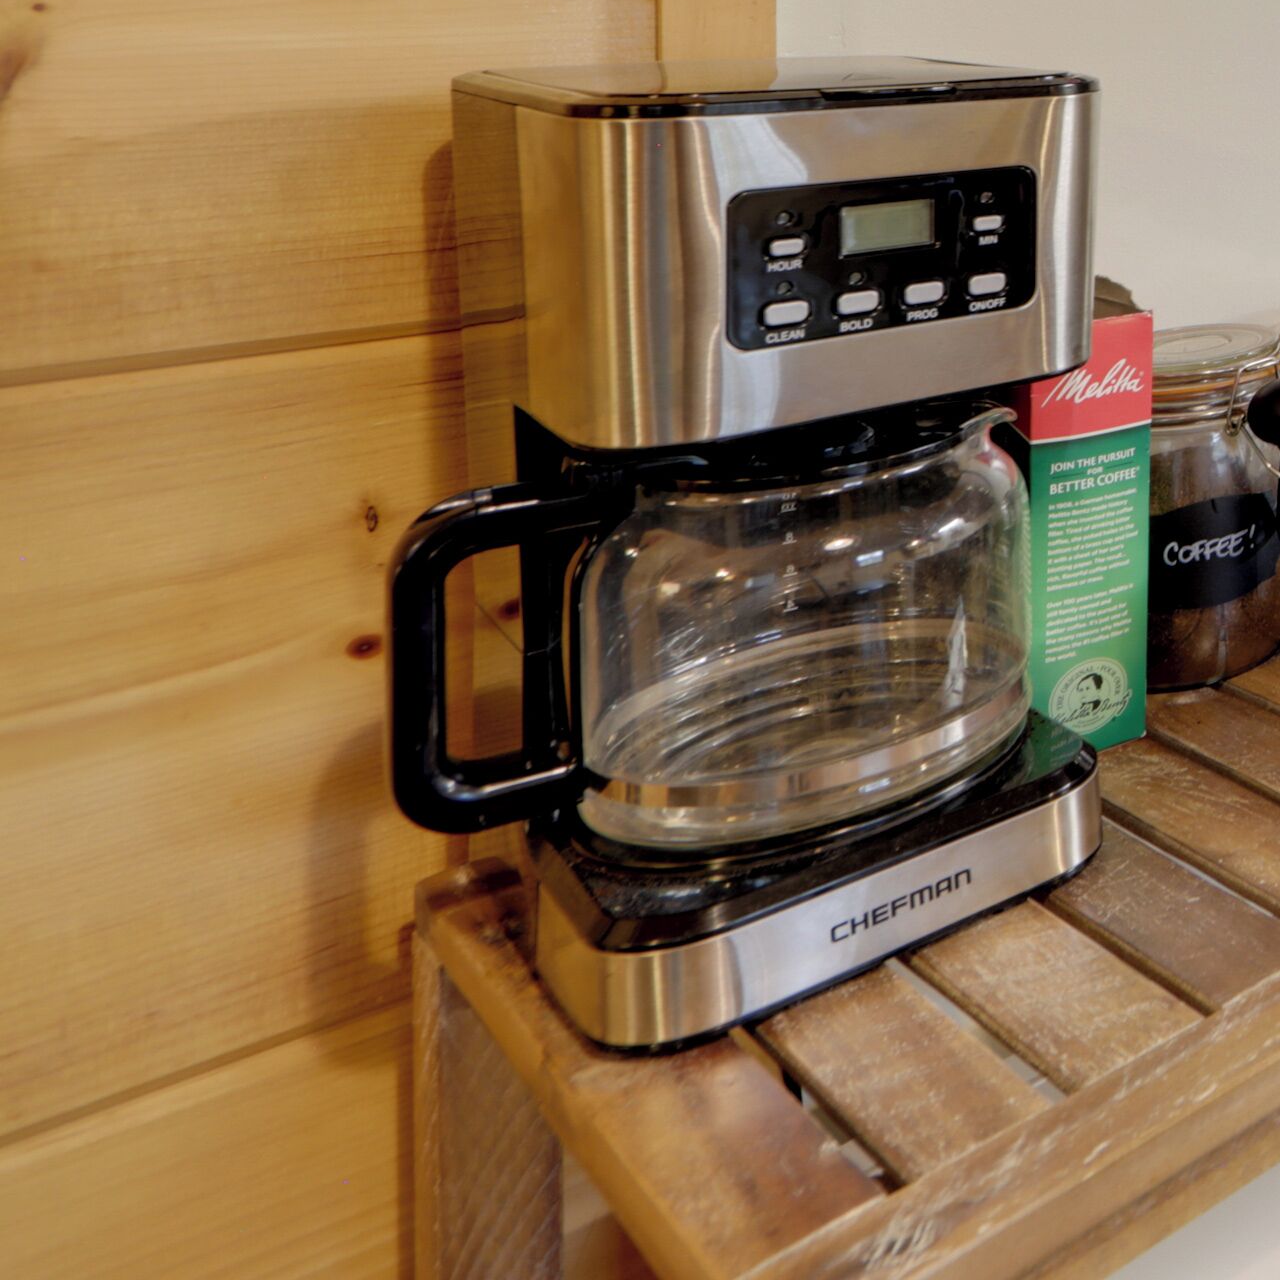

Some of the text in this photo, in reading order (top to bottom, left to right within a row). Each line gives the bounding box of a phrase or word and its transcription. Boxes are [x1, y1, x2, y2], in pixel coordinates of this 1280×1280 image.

[766, 235, 998, 272] HOUR MIN
[765, 297, 1006, 344] CLEAN BOLD PROG ON/OFF
[1041, 358, 1145, 408] Melitta
[1050, 447, 1136, 475] JOIN THE PURSUIT
[1049, 477, 1095, 495] BETTER
[1163, 524, 1256, 567] COFFEE!
[830, 868, 972, 943] CHEFMAN
